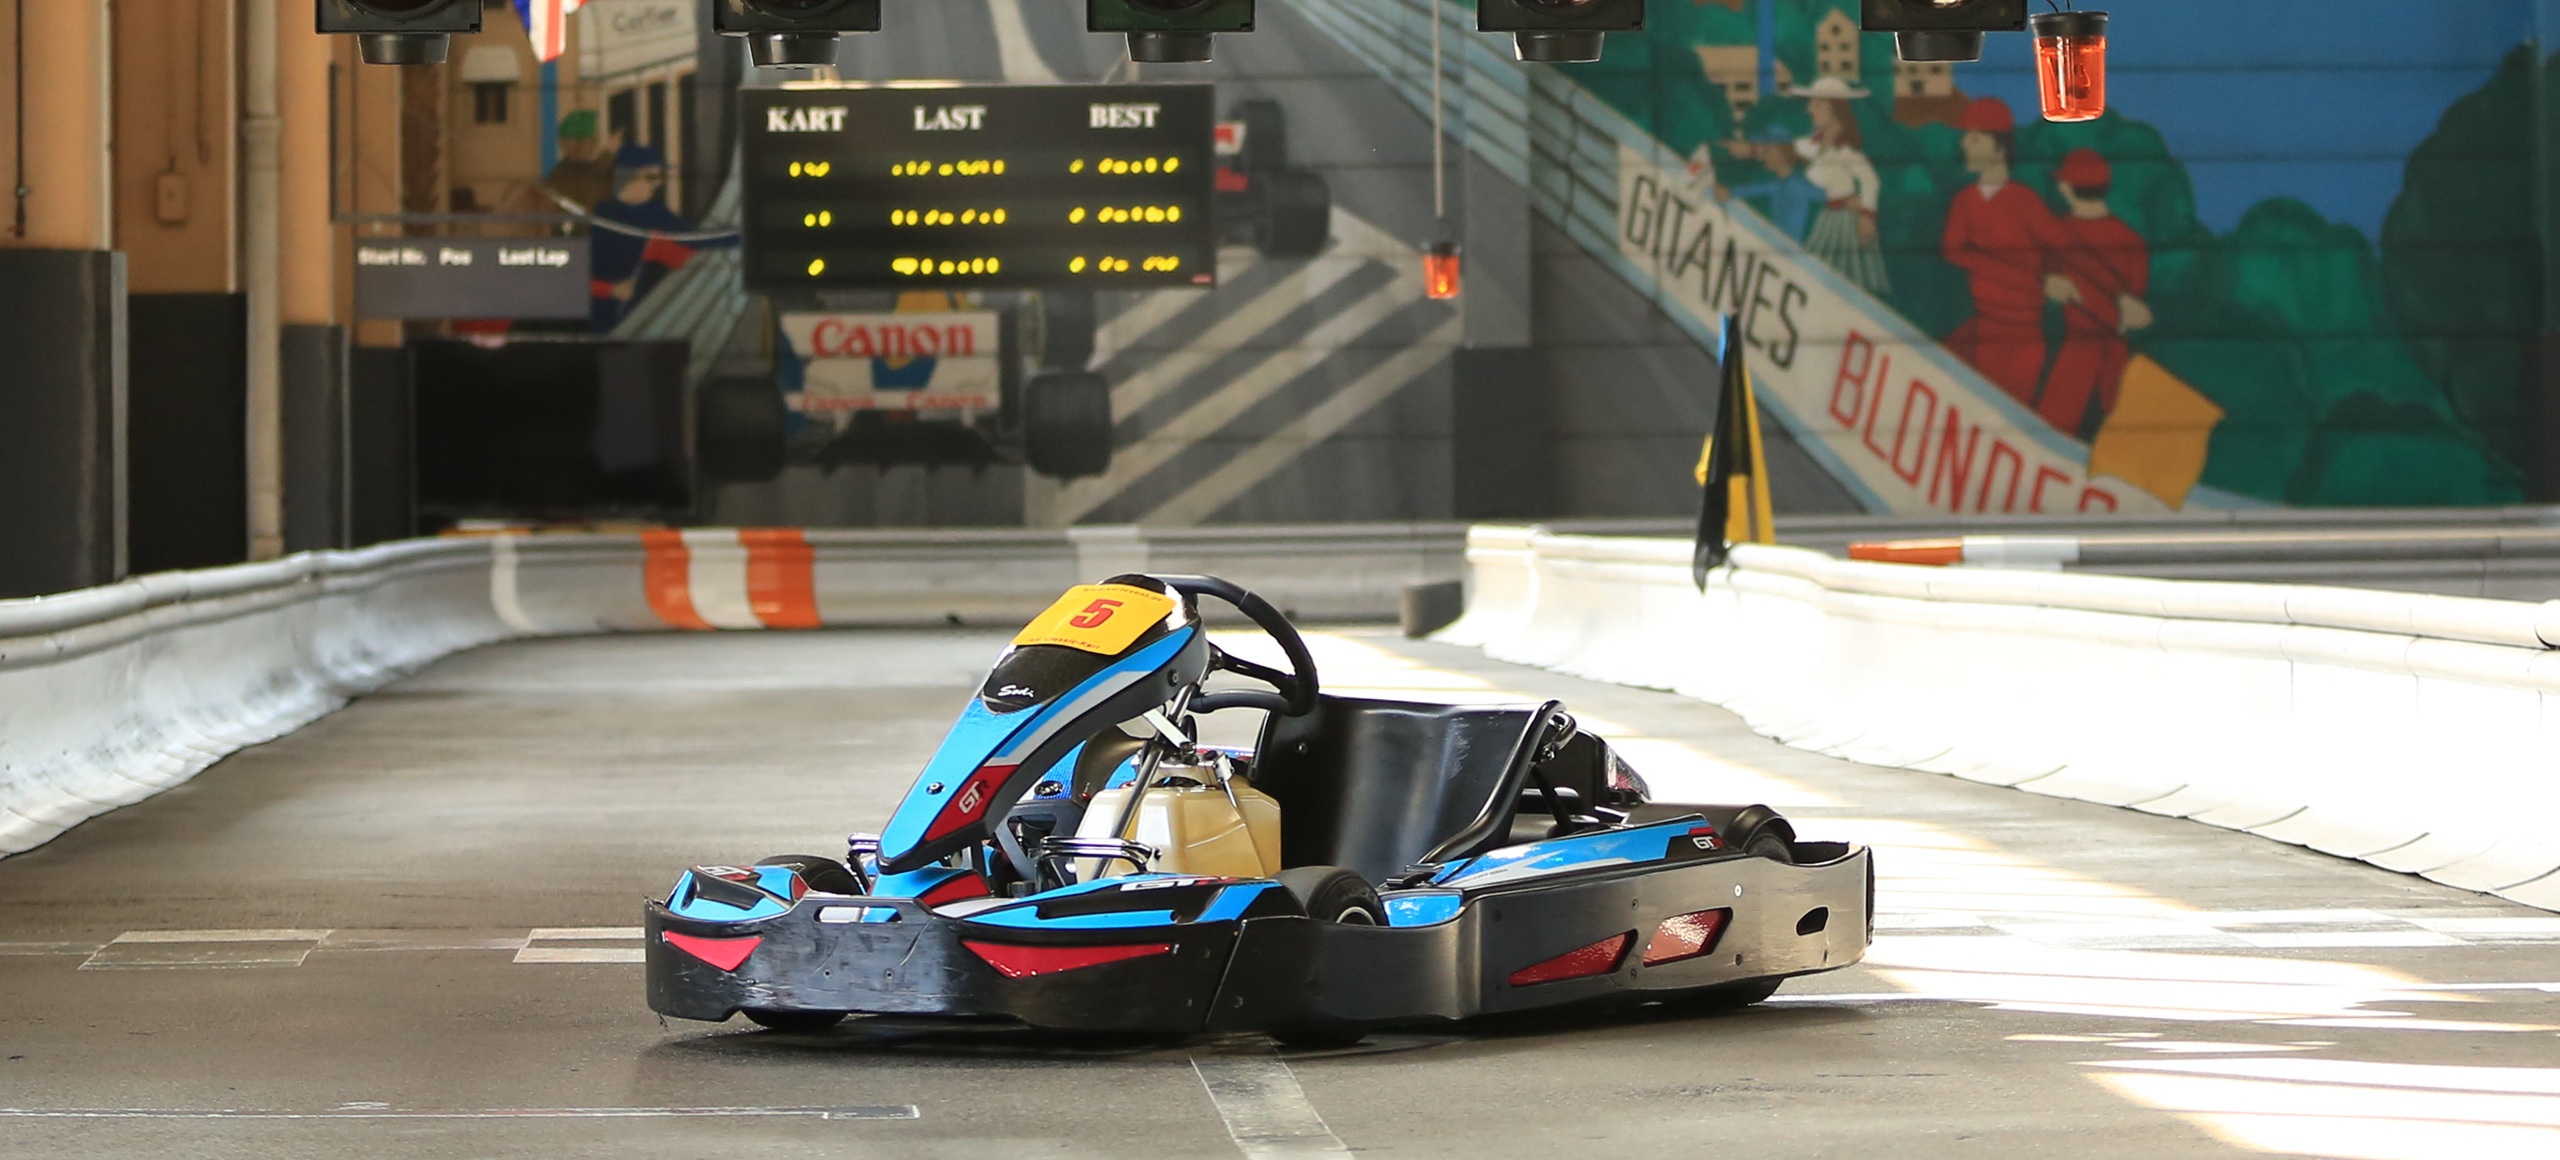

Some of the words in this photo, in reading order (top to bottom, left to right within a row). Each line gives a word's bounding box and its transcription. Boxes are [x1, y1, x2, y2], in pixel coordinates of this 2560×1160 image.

[767, 106, 848, 132] KART
[913, 105, 987, 131] LAST
[1089, 103, 1160, 128] BEST
[498, 246, 535, 266] Last
[537, 246, 570, 268] Lap
[1625, 174, 1808, 371] GITANES
[811, 315, 975, 358] Canon
[1828, 329, 2118, 514] BLOND
[1069, 598, 1124, 629] 5
